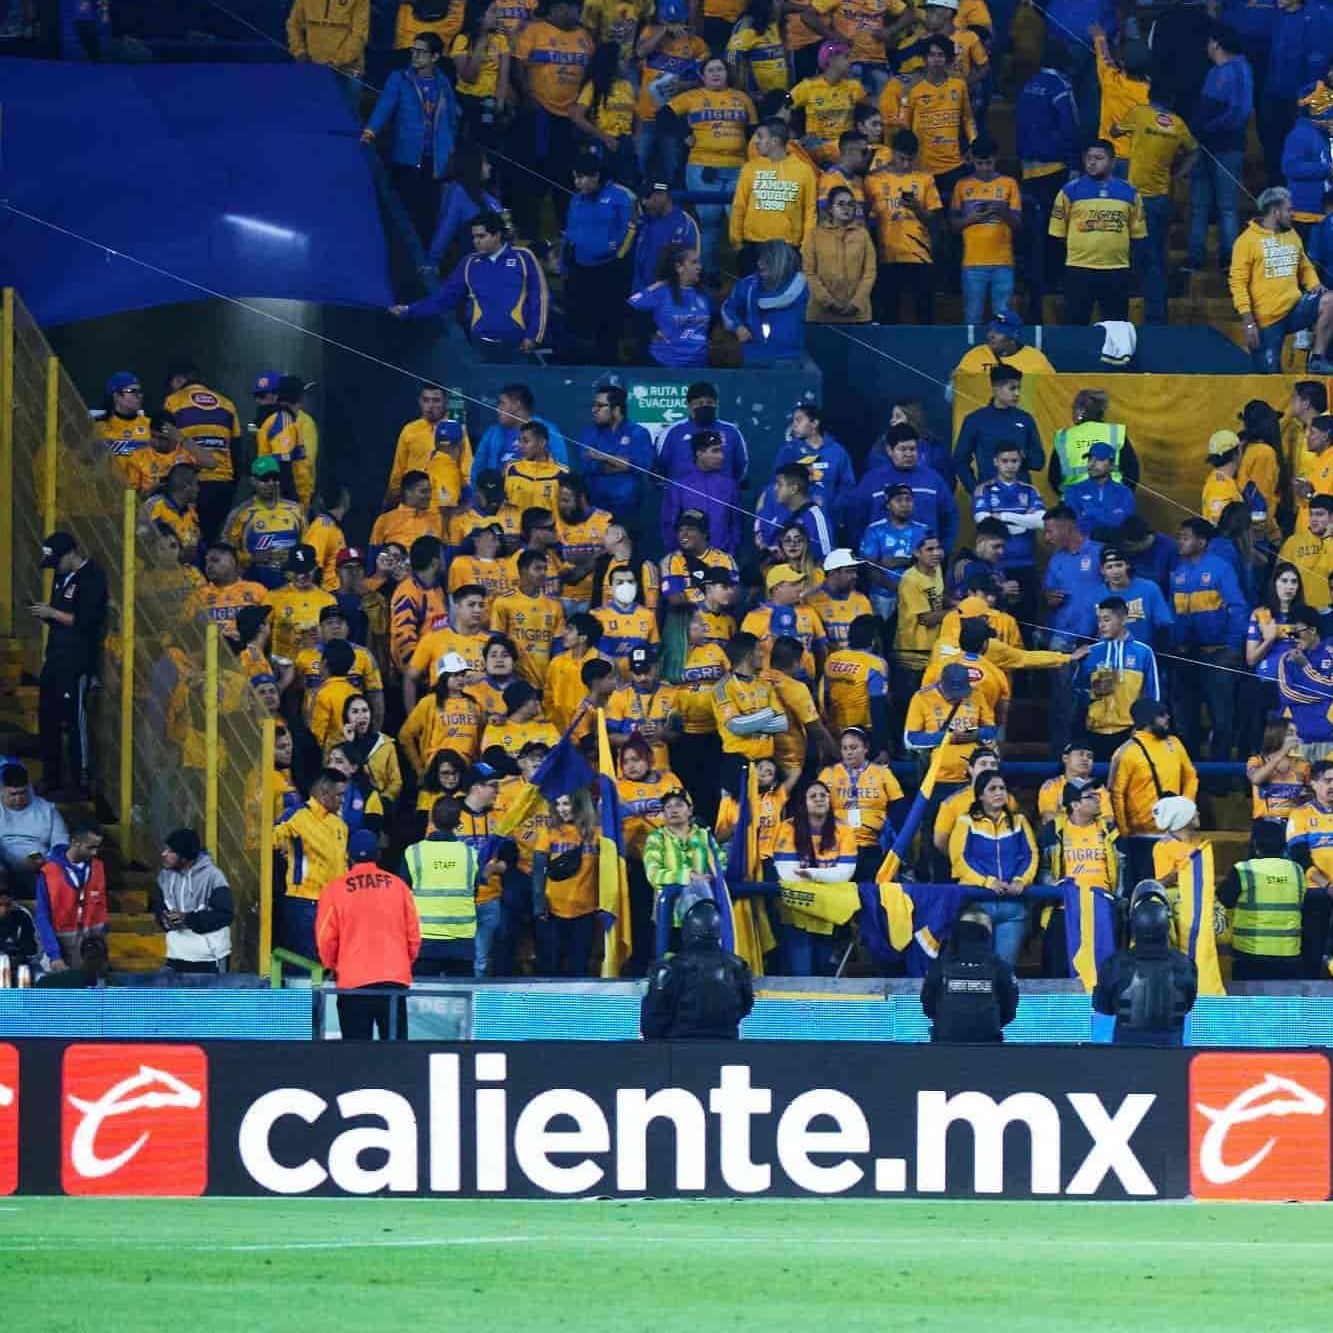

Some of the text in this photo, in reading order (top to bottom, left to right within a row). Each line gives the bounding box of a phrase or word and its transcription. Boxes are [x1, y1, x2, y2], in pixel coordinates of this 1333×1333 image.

[651, 387, 678, 396] RUTA
[639, 398, 689, 408] EVACUAC
[440, 713, 478, 725] TIGRE
[433, 861, 456, 870] STAFF
[346, 874, 392, 892] STAFF
[1267, 876, 1288, 884] STAFF
[238, 1053, 1159, 1195] caliente.mx
